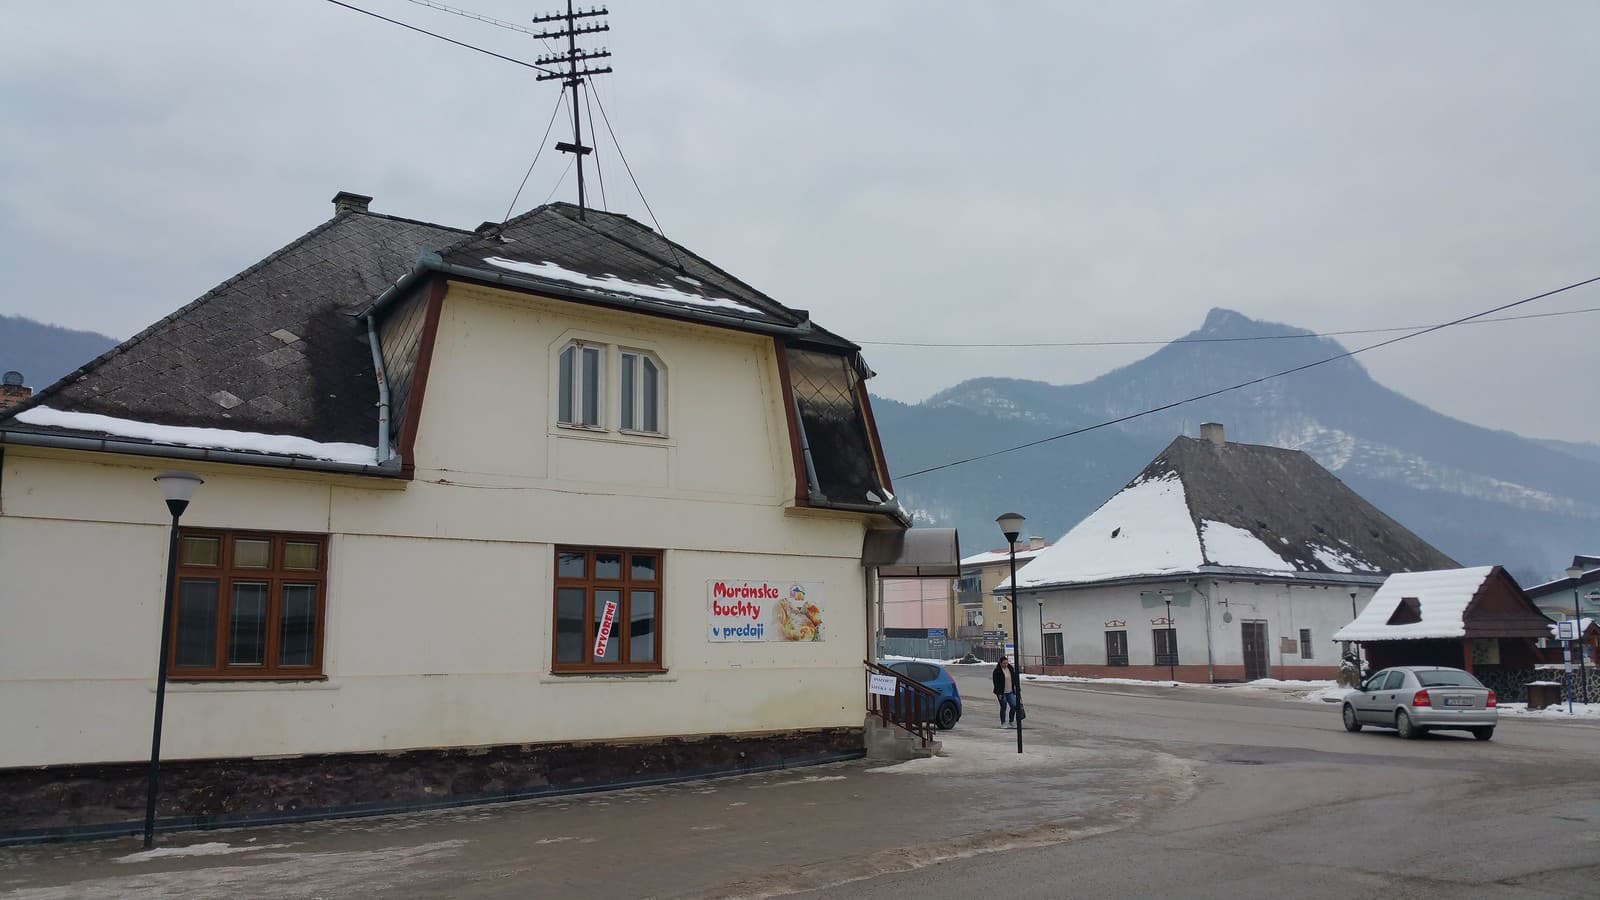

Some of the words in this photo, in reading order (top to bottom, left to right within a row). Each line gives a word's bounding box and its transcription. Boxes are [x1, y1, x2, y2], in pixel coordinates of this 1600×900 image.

[713, 582, 779, 599] Muránske
[713, 600, 760, 620] buchty
[713, 626, 720, 636] v
[724, 624, 764, 639] predaji
